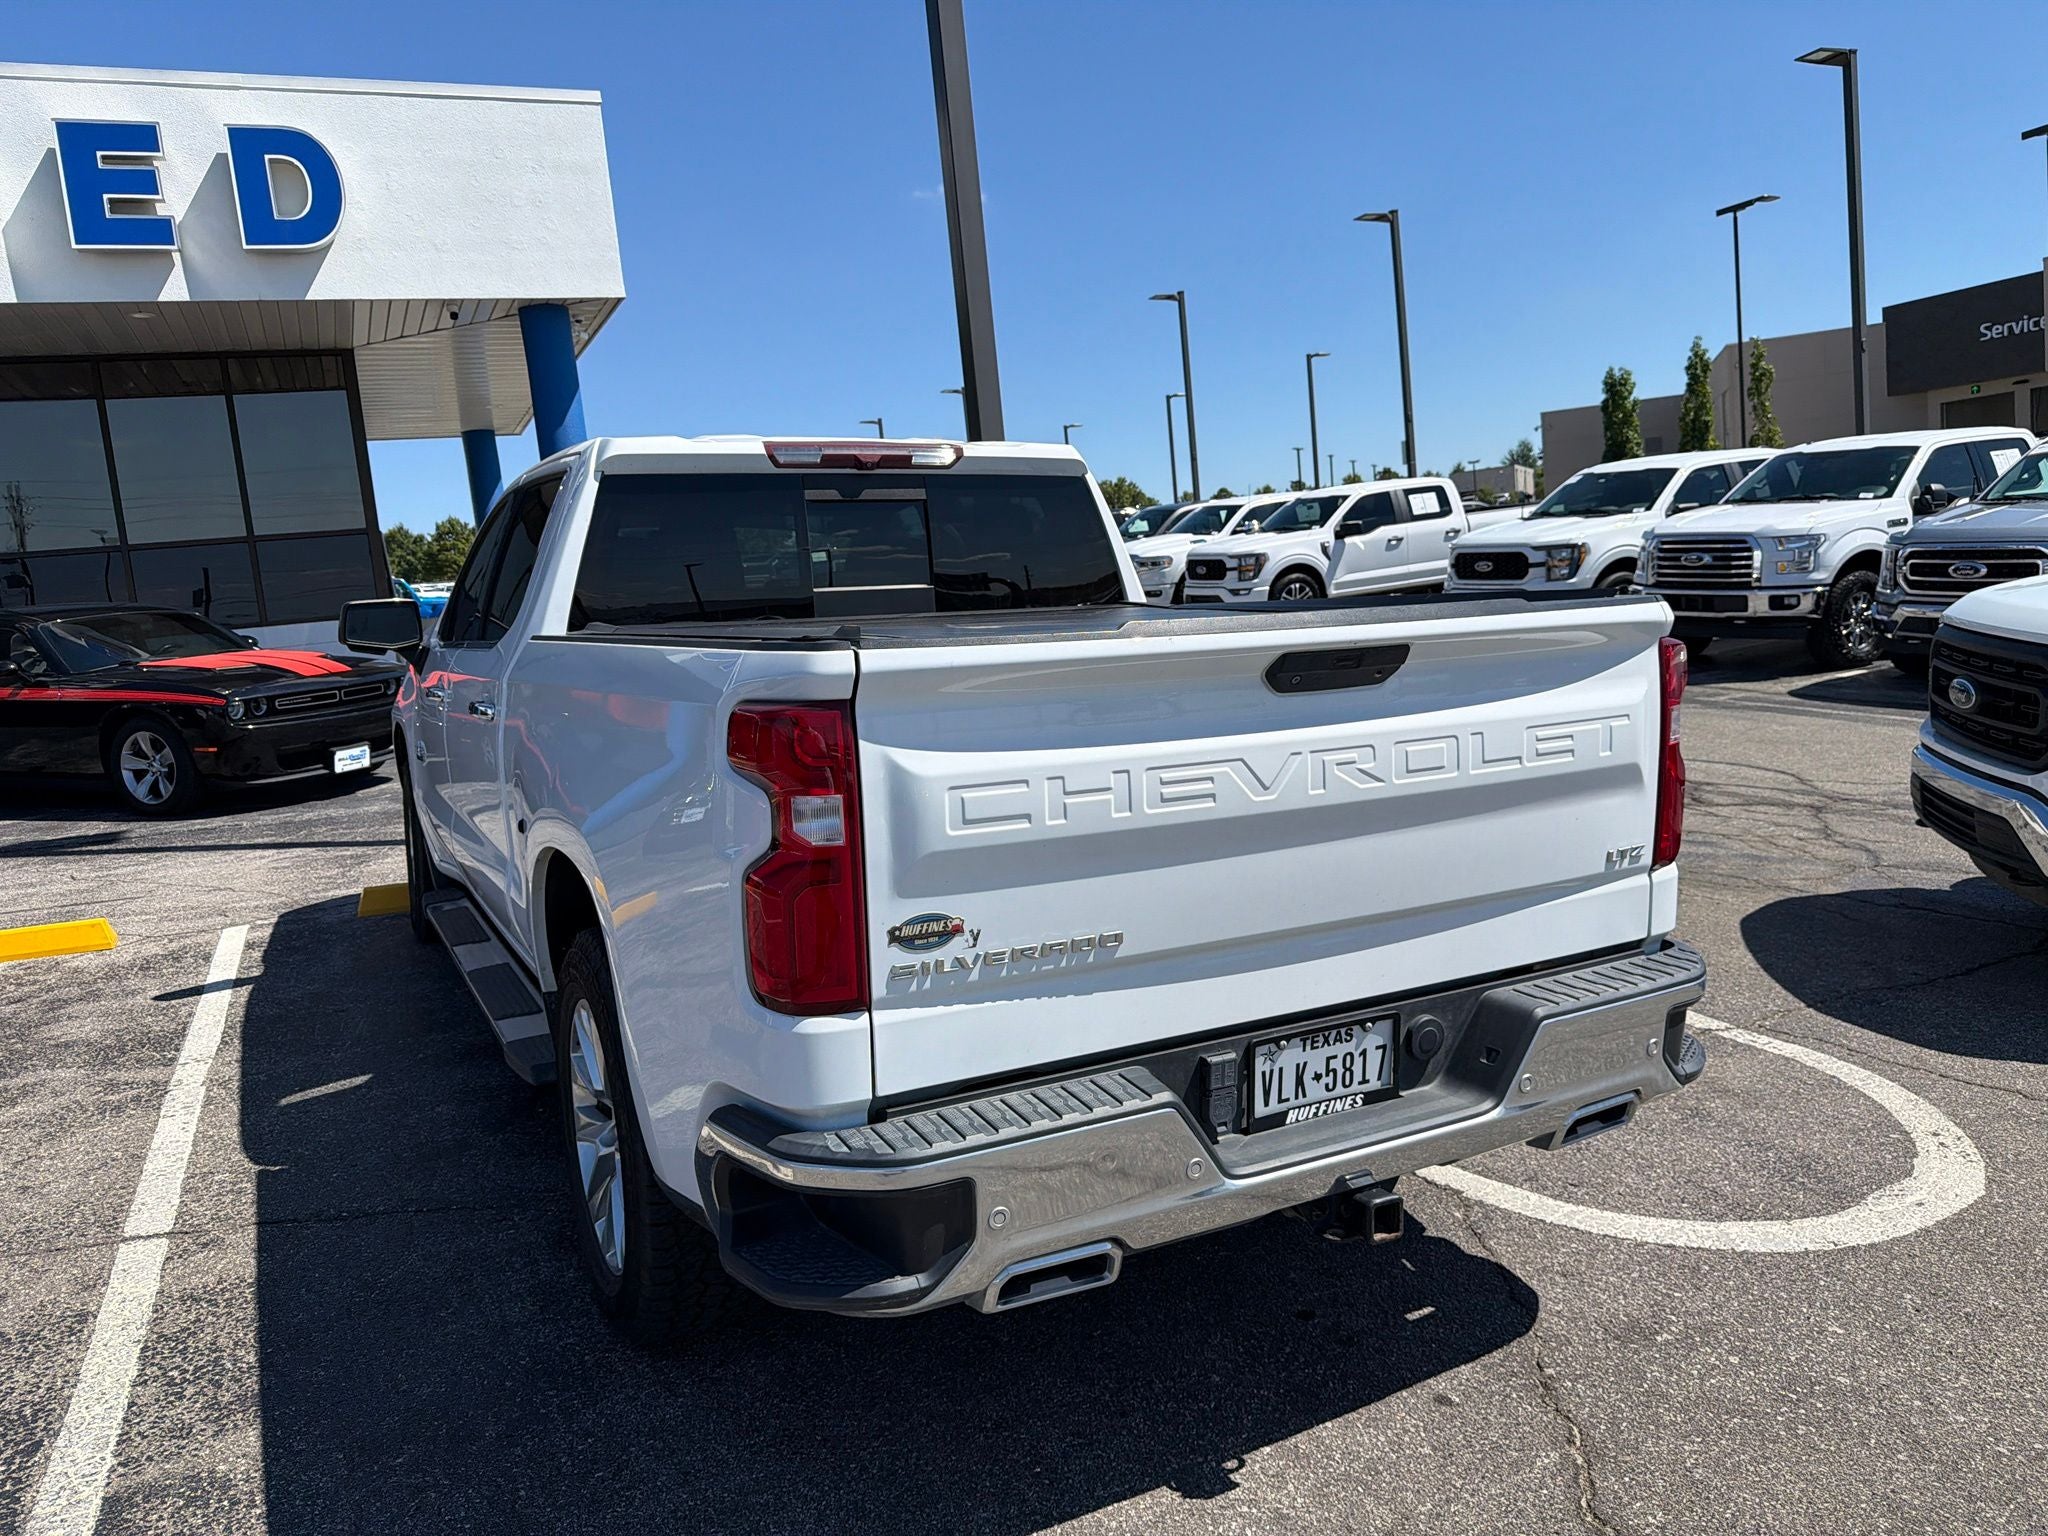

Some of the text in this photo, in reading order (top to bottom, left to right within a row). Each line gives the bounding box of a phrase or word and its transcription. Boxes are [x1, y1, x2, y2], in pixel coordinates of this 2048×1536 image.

[946, 713, 1631, 837] CHEVROLET
[1606, 843, 1646, 864] LTZ
[900, 919, 953, 937] HUFFINES
[889, 930, 1124, 981] SILVERADO
[1300, 1027, 1355, 1053] TEXAS
[1260, 1043, 1388, 1108] VLK 5817
[1285, 1093, 1366, 1126] HUFFINES
